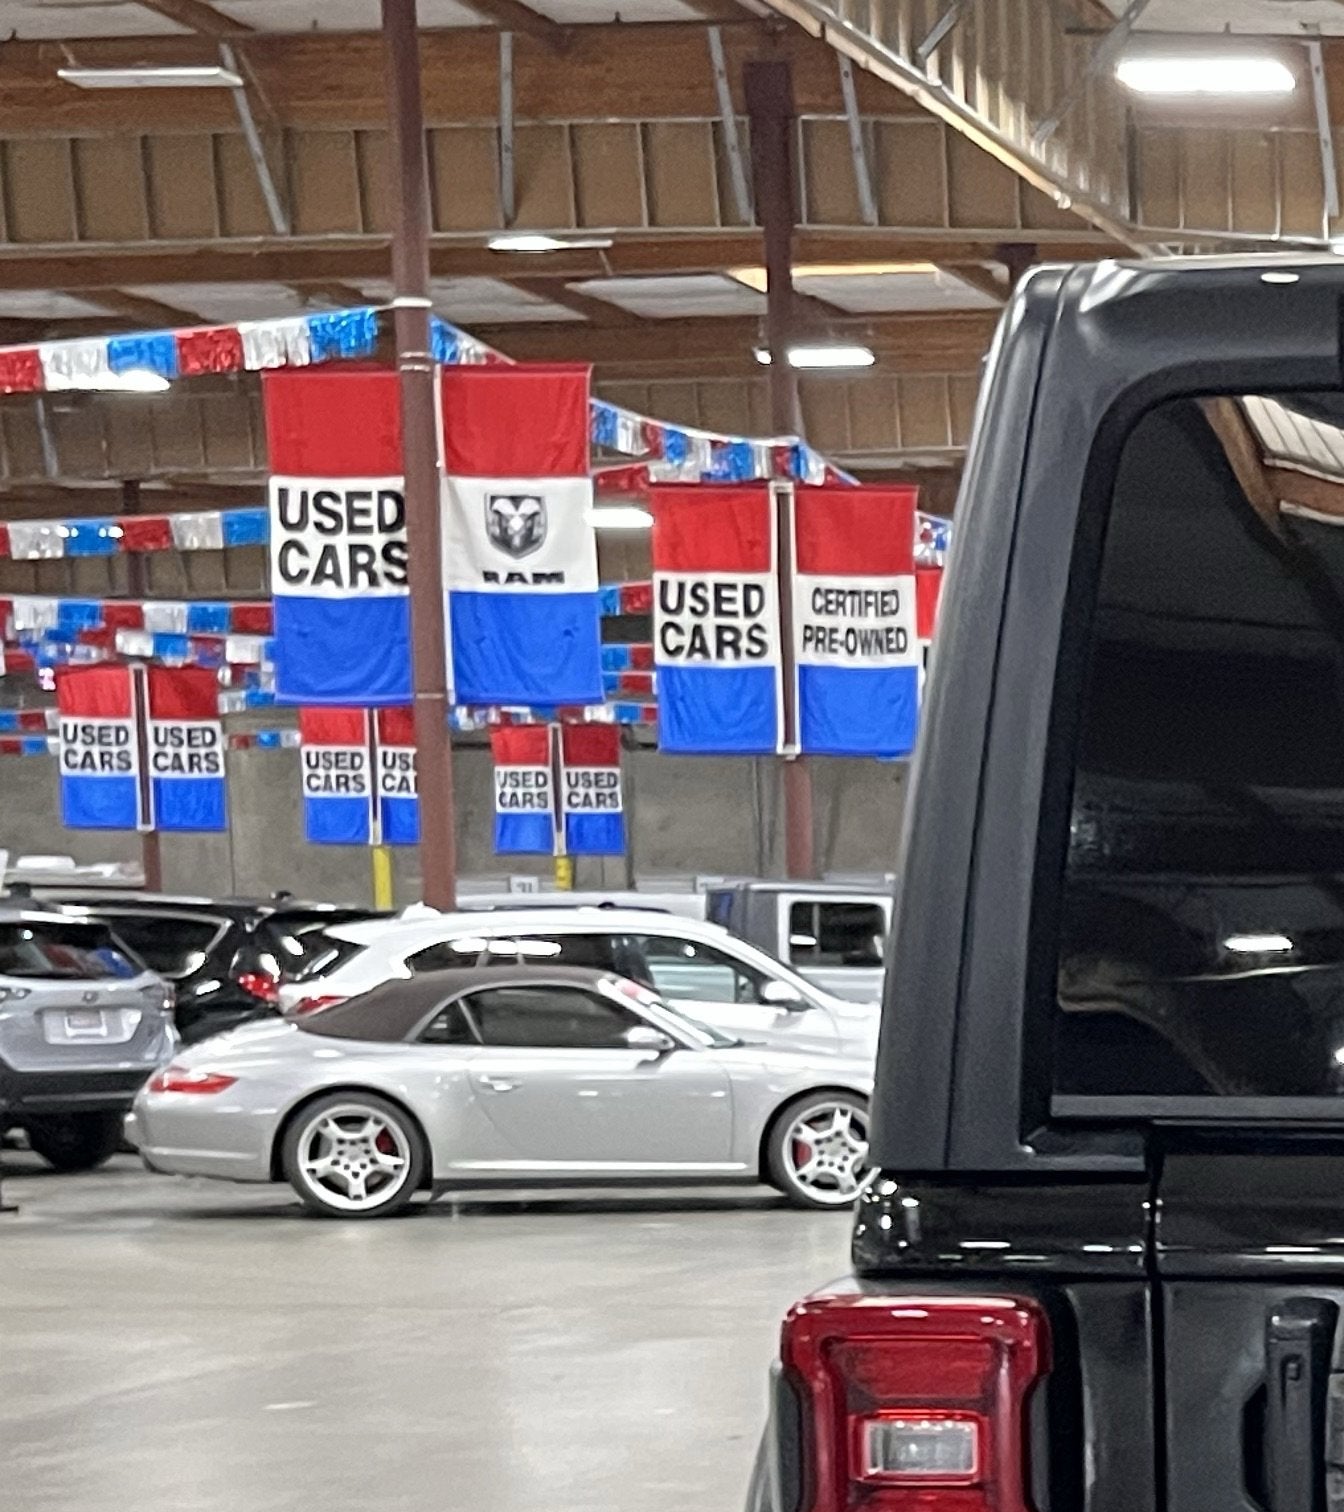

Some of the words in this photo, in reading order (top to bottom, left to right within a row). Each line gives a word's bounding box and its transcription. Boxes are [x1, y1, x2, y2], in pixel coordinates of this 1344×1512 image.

[277, 487, 406, 535] USED
[277, 539, 408, 588] CARS
[482, 570, 565, 584] RAM
[659, 580, 765, 618] USED
[811, 587, 900, 617] CERTIFIED
[660, 621, 769, 659] CARS
[802, 625, 908, 656] PRE-OWNED
[62, 723, 129, 747] USED
[153, 726, 217, 748] USED
[64, 749, 132, 771] CARS
[152, 751, 220, 773] CARS
[306, 751, 364, 771] USED
[306, 773, 366, 793] CARS
[566, 771, 618, 789] USED
[498, 791, 549, 808] CARS
[567, 791, 619, 808] CARS
